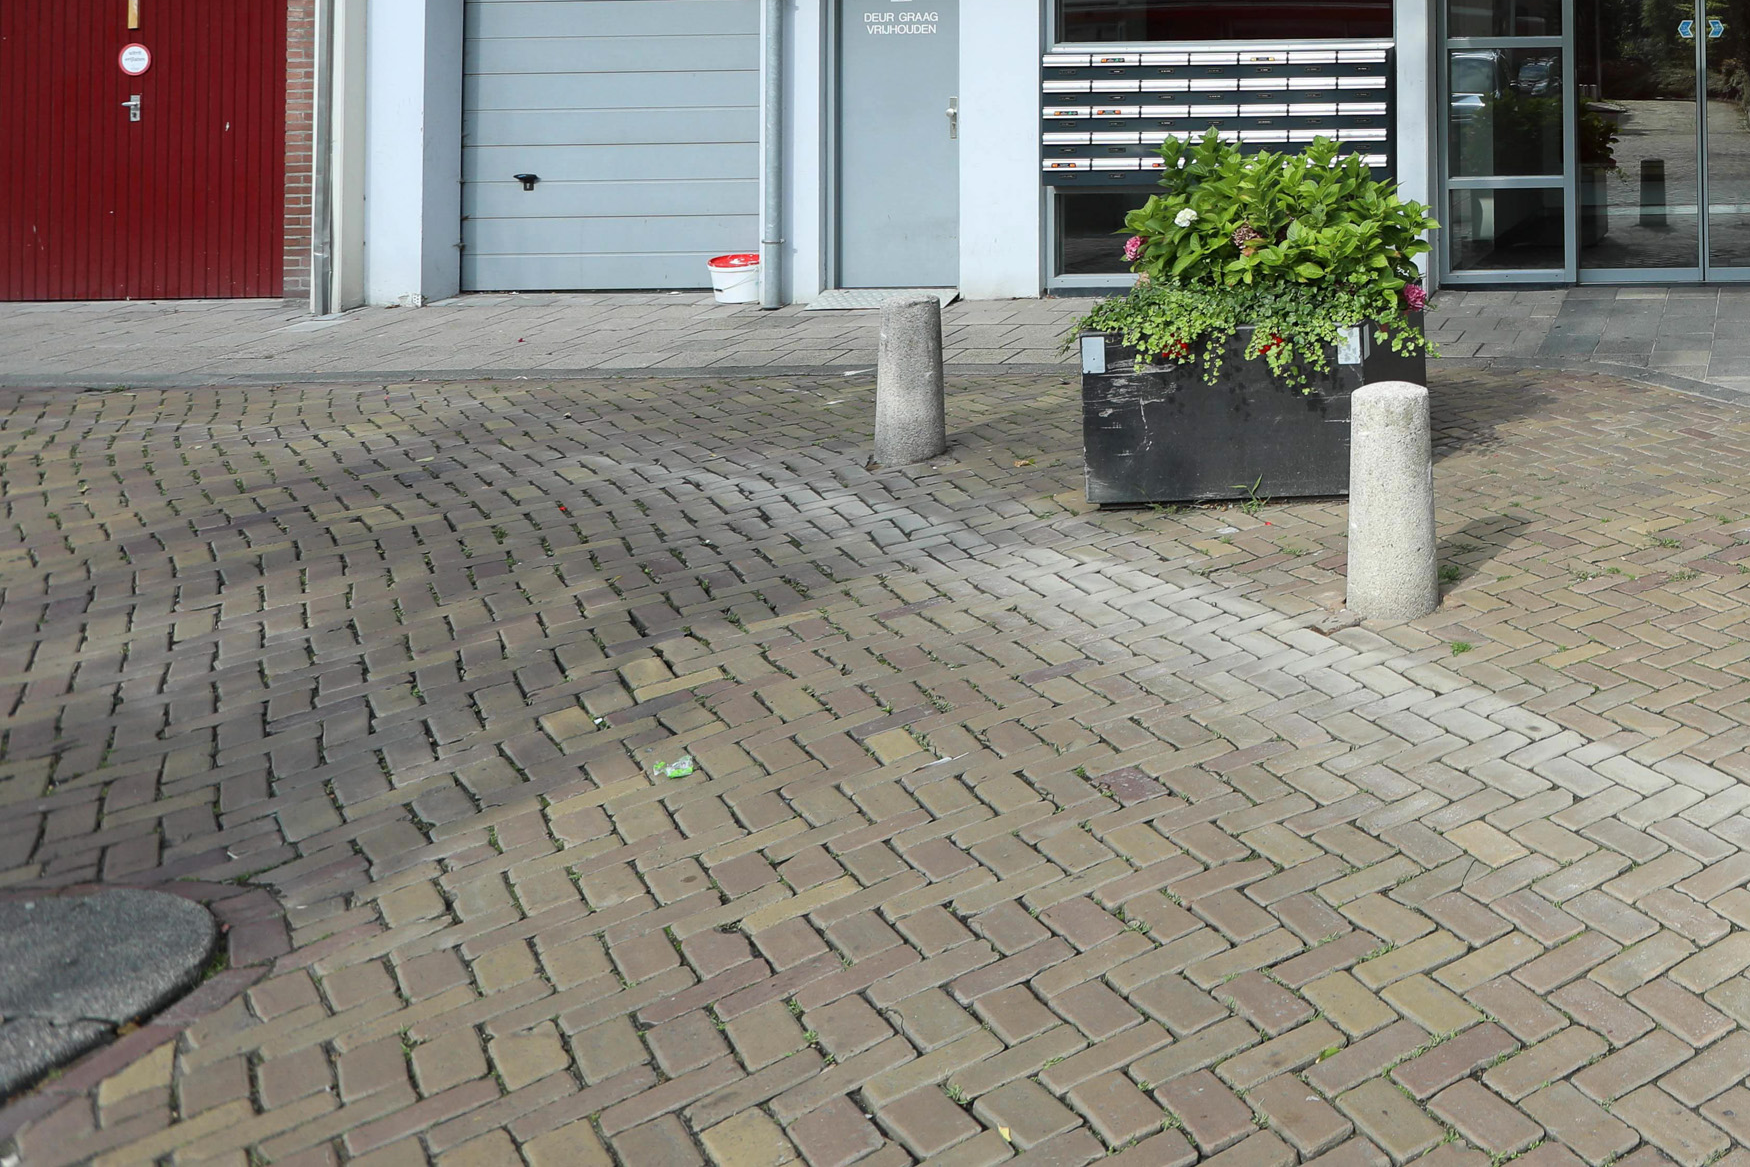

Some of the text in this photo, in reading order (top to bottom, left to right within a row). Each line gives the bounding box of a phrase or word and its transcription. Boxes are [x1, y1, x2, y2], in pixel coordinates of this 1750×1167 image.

[864, 12, 938, 23] DEUR GRAAG
[866, 24, 937, 34] VRIJHOUDEN
